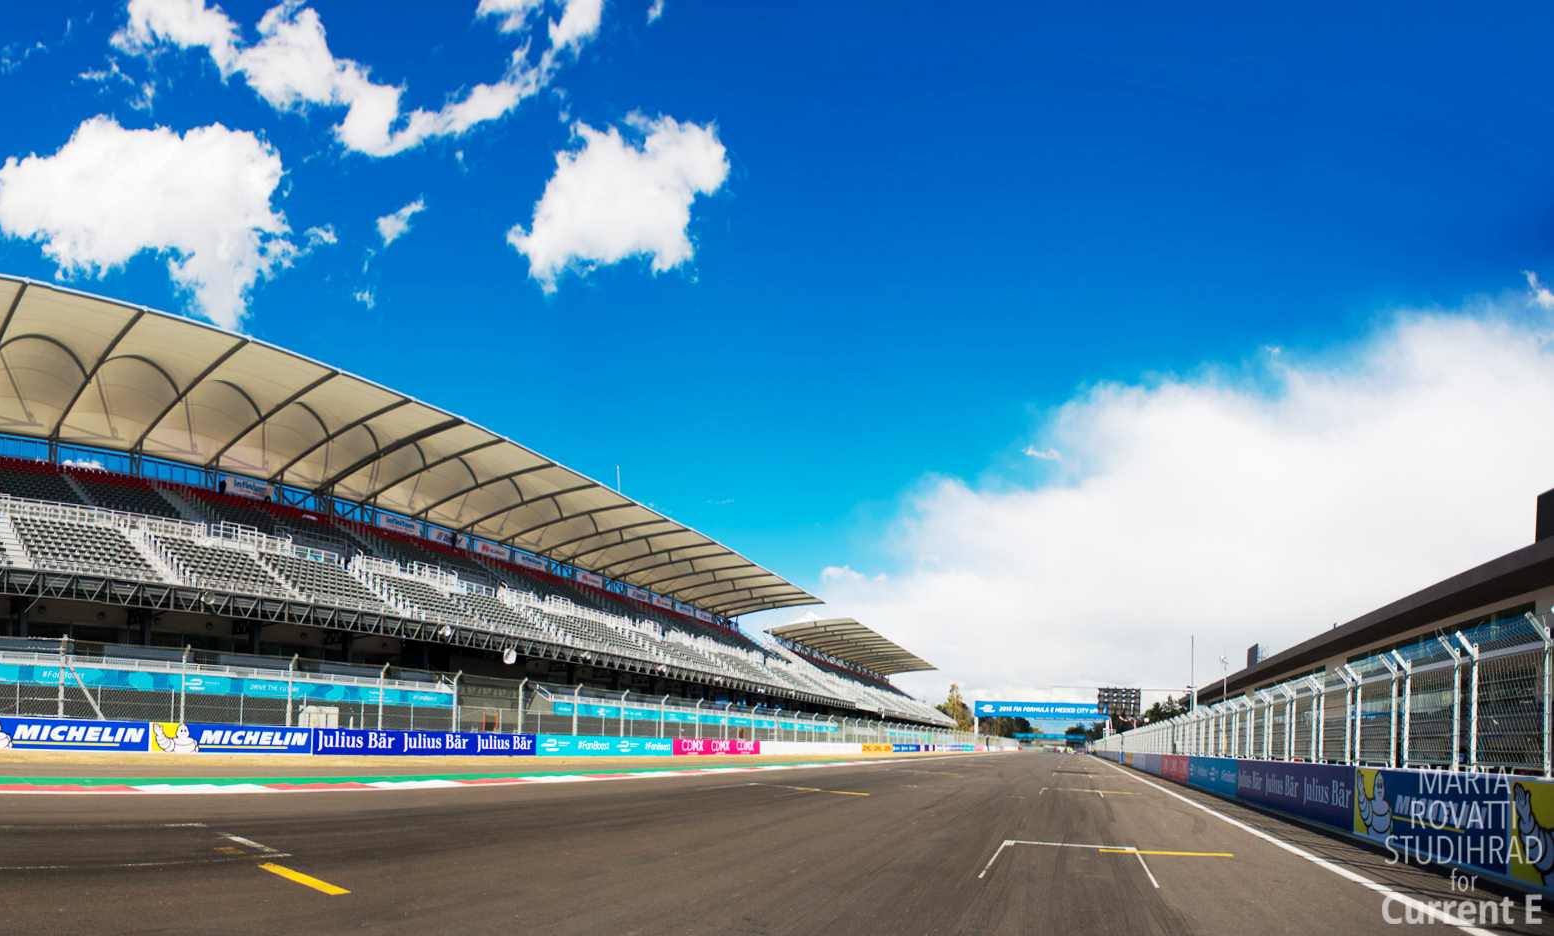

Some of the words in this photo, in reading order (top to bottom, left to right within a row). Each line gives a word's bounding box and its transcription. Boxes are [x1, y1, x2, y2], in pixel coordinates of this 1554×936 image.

[13, 724, 145, 743] MICHELIN
[199, 729, 309, 746] MICHELIN
[317, 730, 364, 751] Julius
[368, 732, 395, 748] Bär
[403, 732, 442, 752] Julius
[445, 734, 469, 749] Bär
[477, 735, 510, 753] Julius
[512, 736, 532, 750] Bär
[577, 740, 610, 750] #FanBoost
[645, 742, 671, 751] #FanBoost
[681, 739, 704, 751] CDMX
[711, 740, 730, 752] CDMX
[736, 740, 754, 751] CDMX
[1237, 769, 1252, 789] Julius
[1252, 771, 1262, 790] Bär
[1265, 772, 1284, 796] Julius
[1285, 774, 1299, 798] Bär
[1303, 776, 1329, 805] Julius
[1331, 780, 1351, 808] Bär
